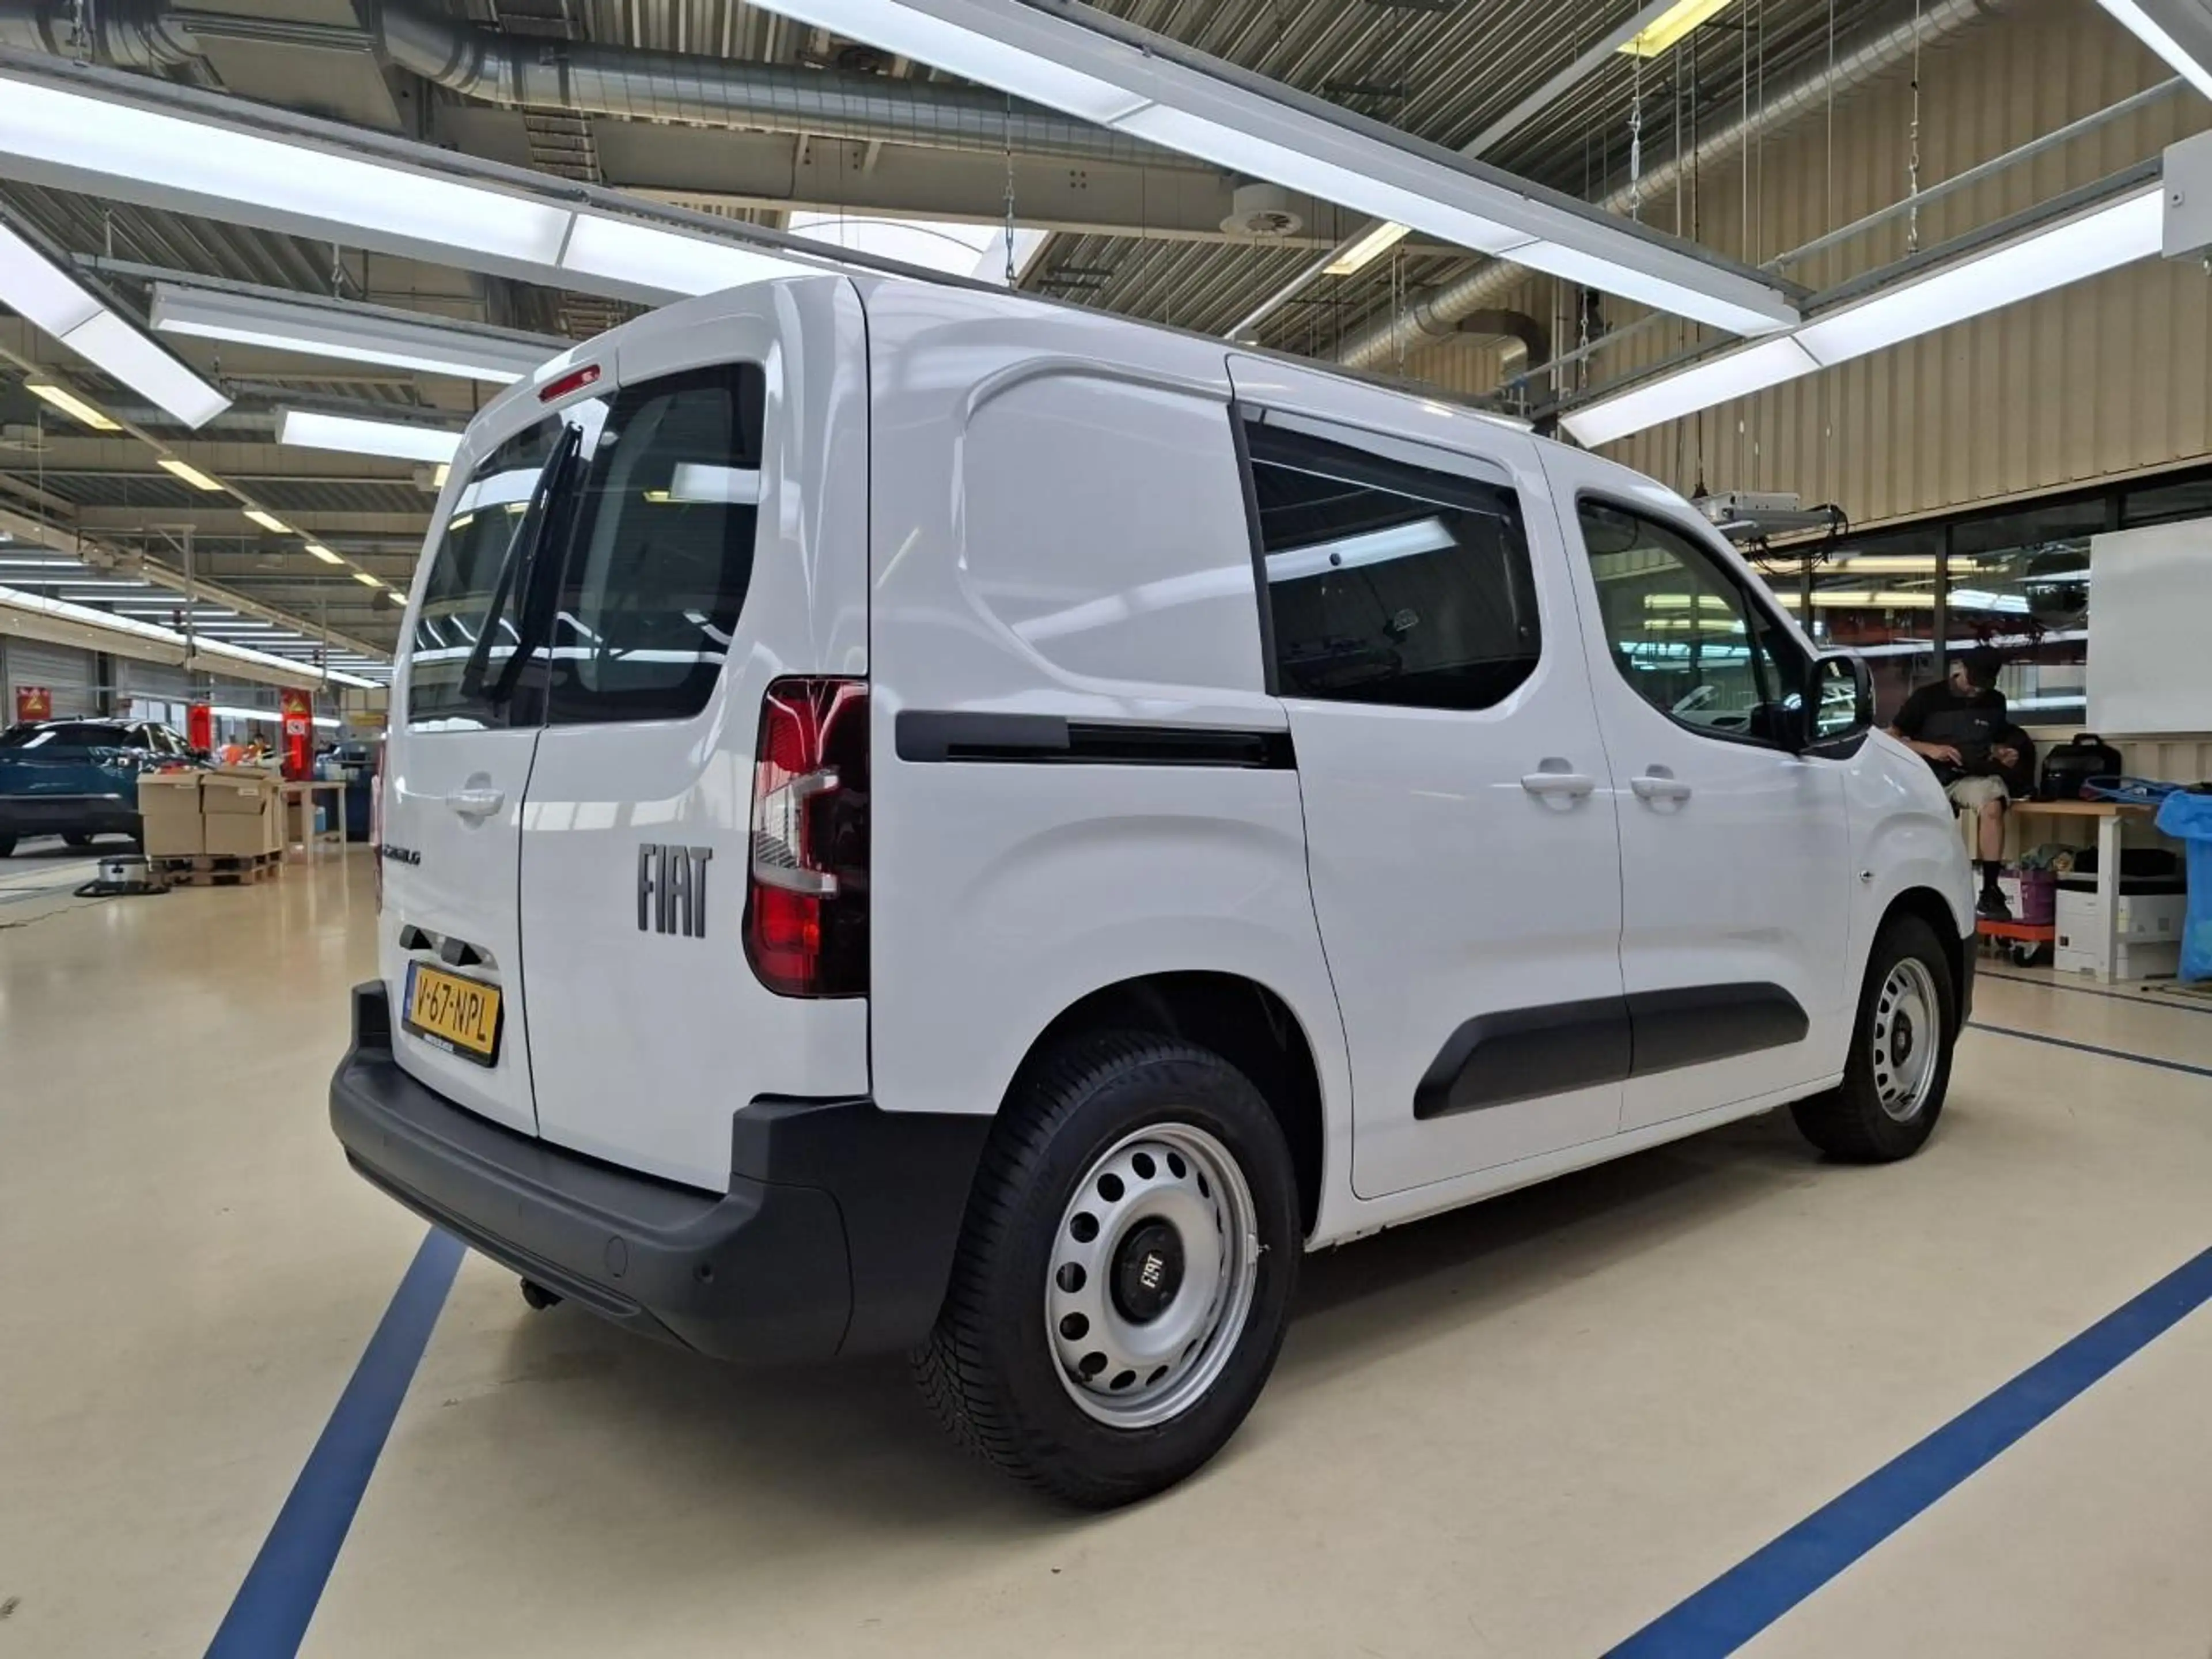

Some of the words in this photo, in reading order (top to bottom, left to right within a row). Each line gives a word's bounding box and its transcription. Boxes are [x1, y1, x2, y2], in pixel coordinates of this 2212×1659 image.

[638, 843, 713, 939] FIAT
[417, 976, 486, 1043] V-67-NPL
[1141, 1253, 1162, 1289] FIAT
